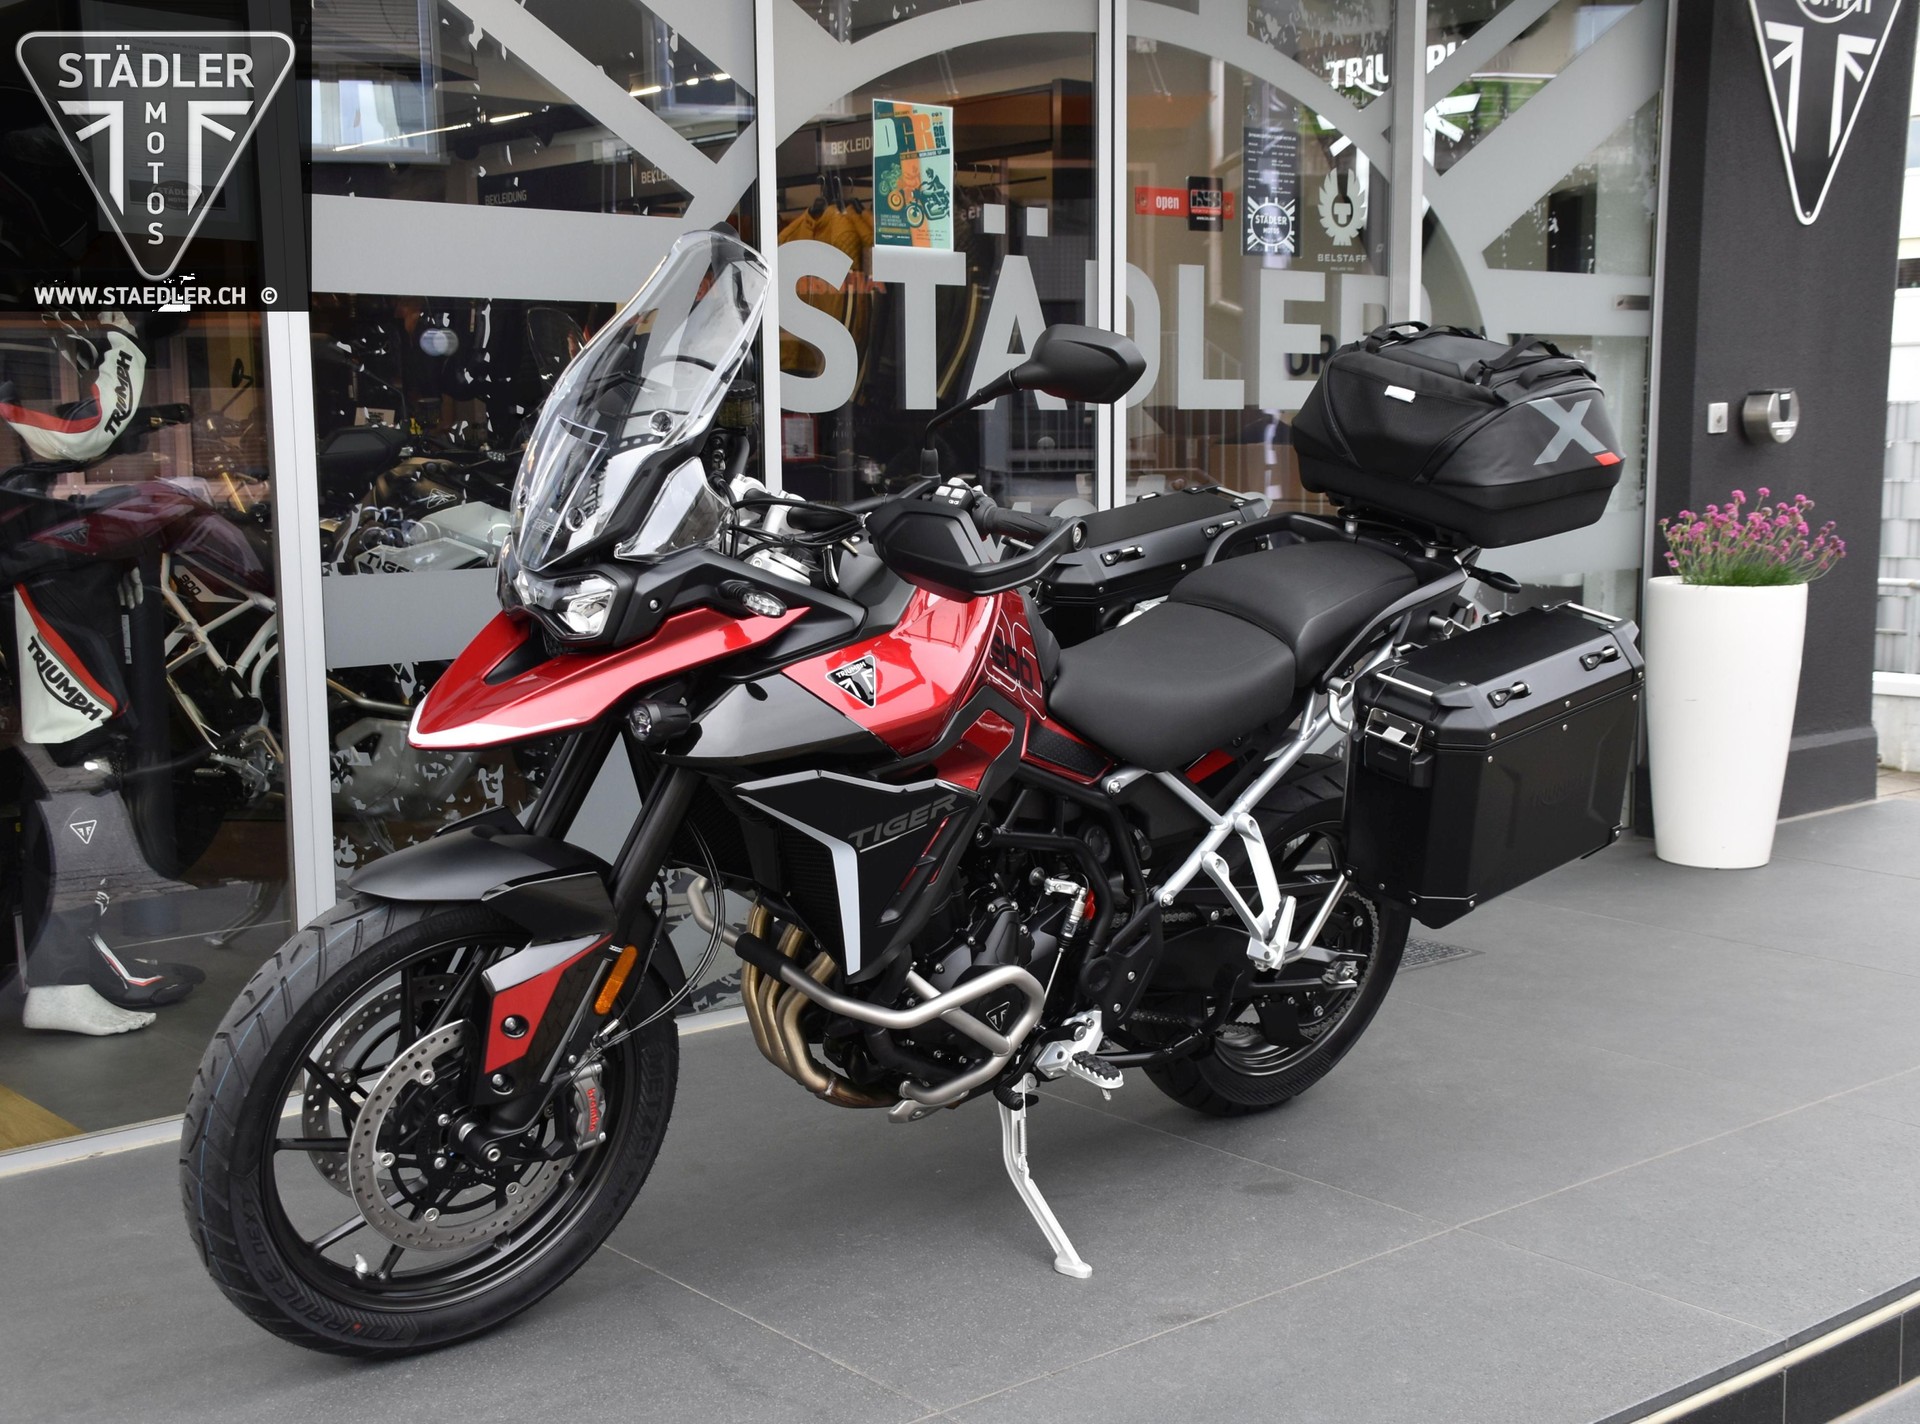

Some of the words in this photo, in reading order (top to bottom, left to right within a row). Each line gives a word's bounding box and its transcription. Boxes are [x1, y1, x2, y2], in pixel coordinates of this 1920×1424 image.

[641, 169, 670, 184] BEKLE
[484, 190, 527, 205] BEKLEIDUNG
[1155, 195, 1180, 210] open
[1255, 213, 1288, 226] STÄDLER
[1317, 253, 1368, 263] BELSTAFF
[104, 350, 133, 436] TRIUMPH
[366, 552, 414, 574] TIGE
[181, 574, 202, 596] 900
[27, 635, 103, 722] TRIUMPH
[835, 661, 867, 678] TRIUMPH
[847, 793, 957, 848] TIGER
[586, 1087, 600, 1132] brembo
